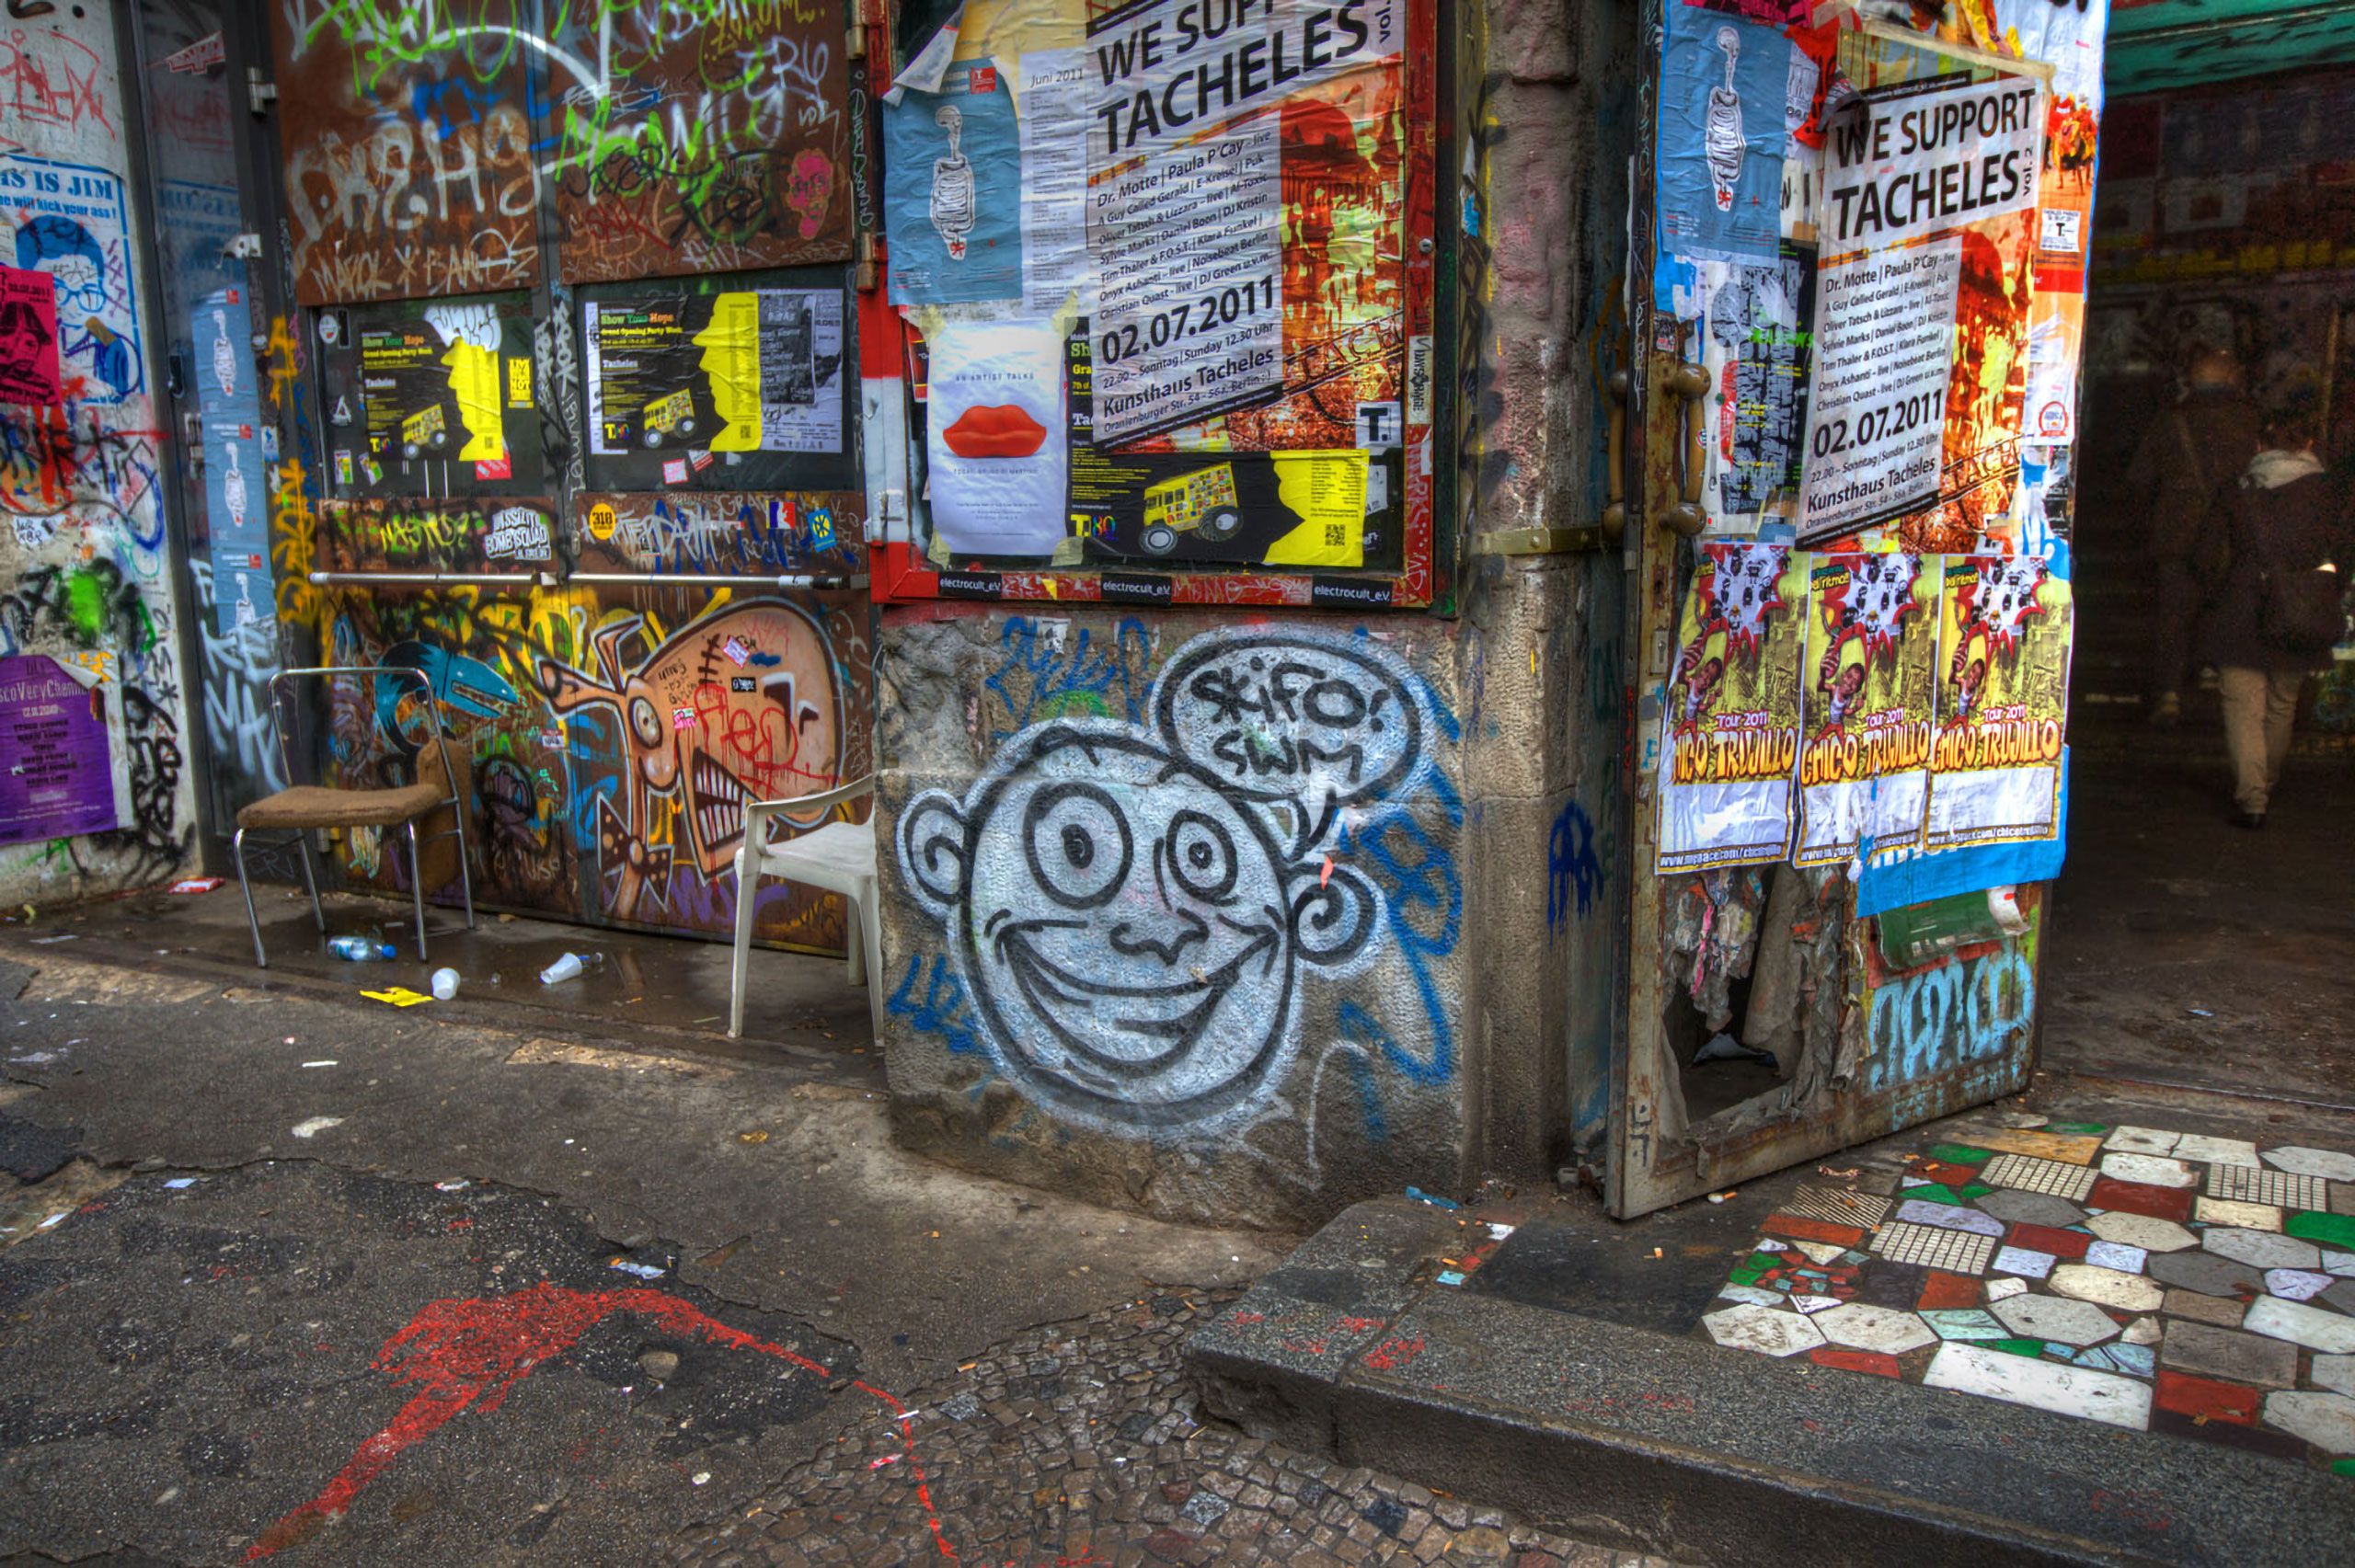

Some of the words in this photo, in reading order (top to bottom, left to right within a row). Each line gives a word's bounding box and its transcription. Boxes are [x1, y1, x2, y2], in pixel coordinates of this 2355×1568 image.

[1030, 73, 1053, 88] Juni
[1056, 67, 1084, 82] 2011
[1097, 21, 1163, 86] WE
[1097, 0, 1369, 154] TACHELES
[1837, 117, 1890, 167] WE
[1901, 88, 2036, 155] SUPPORT
[33, 170, 60, 193] IS
[67, 175, 113, 200] JIM
[1097, 193, 1115, 207] Dr.
[1119, 174, 1157, 200] Motte
[1168, 155, 1204, 179] Paula
[1253, 132, 1271, 145] live
[1098, 216, 1105, 226] A
[1107, 209, 1125, 223] Guy
[1127, 197, 1156, 215] Called
[1157, 183, 1189, 204] Gerald
[1245, 155, 1264, 169] Puk
[13, 196, 35, 210] will
[36, 198, 62, 212] kick
[63, 201, 89, 216] your
[90, 204, 110, 219] ass
[1098, 229, 1125, 245] Oliver
[1127, 217, 1155, 235] Tatsch
[1207, 189, 1223, 203] live
[1832, 150, 2019, 241] TACHELES
[1128, 236, 1155, 253] Marks
[1161, 221, 1191, 240] Daniel
[1193, 212, 1217, 229] Boon
[1223, 204, 1235, 218] DJ
[1235, 192, 1268, 213] Kristin
[1099, 286, 1124, 302] Onyx
[1125, 271, 1161, 292] Ashanti
[1169, 263, 1186, 277] live
[1192, 243, 1239, 268] Noisebeat
[1241, 232, 1269, 249] Berlin
[1101, 269, 1118, 283] Tim
[1120, 258, 1149, 276] Thaler
[1198, 230, 1223, 246] Klara
[1825, 278, 1841, 293] Dr.
[1844, 269, 1877, 289] Motte
[1885, 259, 1912, 280] Paula
[1943, 253, 1956, 264] live
[1142, 289, 1169, 305] Quast
[1176, 280, 1192, 293] live
[1200, 272, 1211, 285] DJ
[1212, 262, 1242, 280] Green
[1832, 300, 1848, 312] Guy
[1850, 292, 1874, 307] Called
[1876, 286, 1900, 302] Gerald
[1102, 274, 1273, 364] 02.07.2011
[1823, 320, 1847, 333] Oliver
[1848, 312, 1872, 326] Tatsch
[1909, 299, 1921, 311] live
[1846, 332, 1870, 347] Marks
[1918, 315, 1926, 326] DJ
[1103, 372, 1129, 390] 22.00
[1139, 356, 1179, 377] Sonntag
[1184, 339, 1222, 361] Sunday
[1225, 329, 1253, 347] 12.30
[1255, 323, 1274, 338] Uhr
[1819, 380, 1839, 393] Onyx
[1840, 371, 1871, 386] Ashanti
[1878, 365, 1889, 377] live
[1925, 347, 1947, 361] Berlin
[1821, 361, 1837, 372] Tim
[1837, 353, 1862, 368] Thaler
[1104, 376, 1193, 418] Kunsthaus
[1197, 349, 1274, 387] Tacheles
[1817, 395, 1851, 411] Christian
[1853, 388, 1877, 402] Quast
[1880, 383, 1892, 395] live
[1896, 377, 1905, 388] DJ
[1905, 372, 1924, 385] Green
[1104, 403, 1169, 433] Oranienburger
[1813, 388, 1942, 458] 02.07.2011
[1808, 476, 1884, 513] Kunsthaus
[1887, 457, 1936, 487] Tacheles
[1810, 467, 1834, 483] 22.00
[1843, 456, 1877, 473] Sonntag
[1881, 446, 1907, 462] Sunday
[515, 525, 548, 547] SQUAD
[1806, 506, 1863, 530] Oranienburger
[1717, 715, 1741, 727] Tour
[1743, 711, 1768, 726] 2011
[1865, 715, 1884, 727] Tour
[1886, 707, 1904, 725] 2011
[1983, 708, 2004, 721] Tour
[2005, 704, 2027, 719] 2011
[1673, 732, 1708, 781] HICO
[1712, 727, 1795, 779] TRUJILLO
[1799, 732, 1858, 785] CHICO
[1862, 719, 1930, 775] TRUJILLO
[1931, 724, 1977, 772] CHICO
[1980, 718, 2061, 766] TRUJILLO
